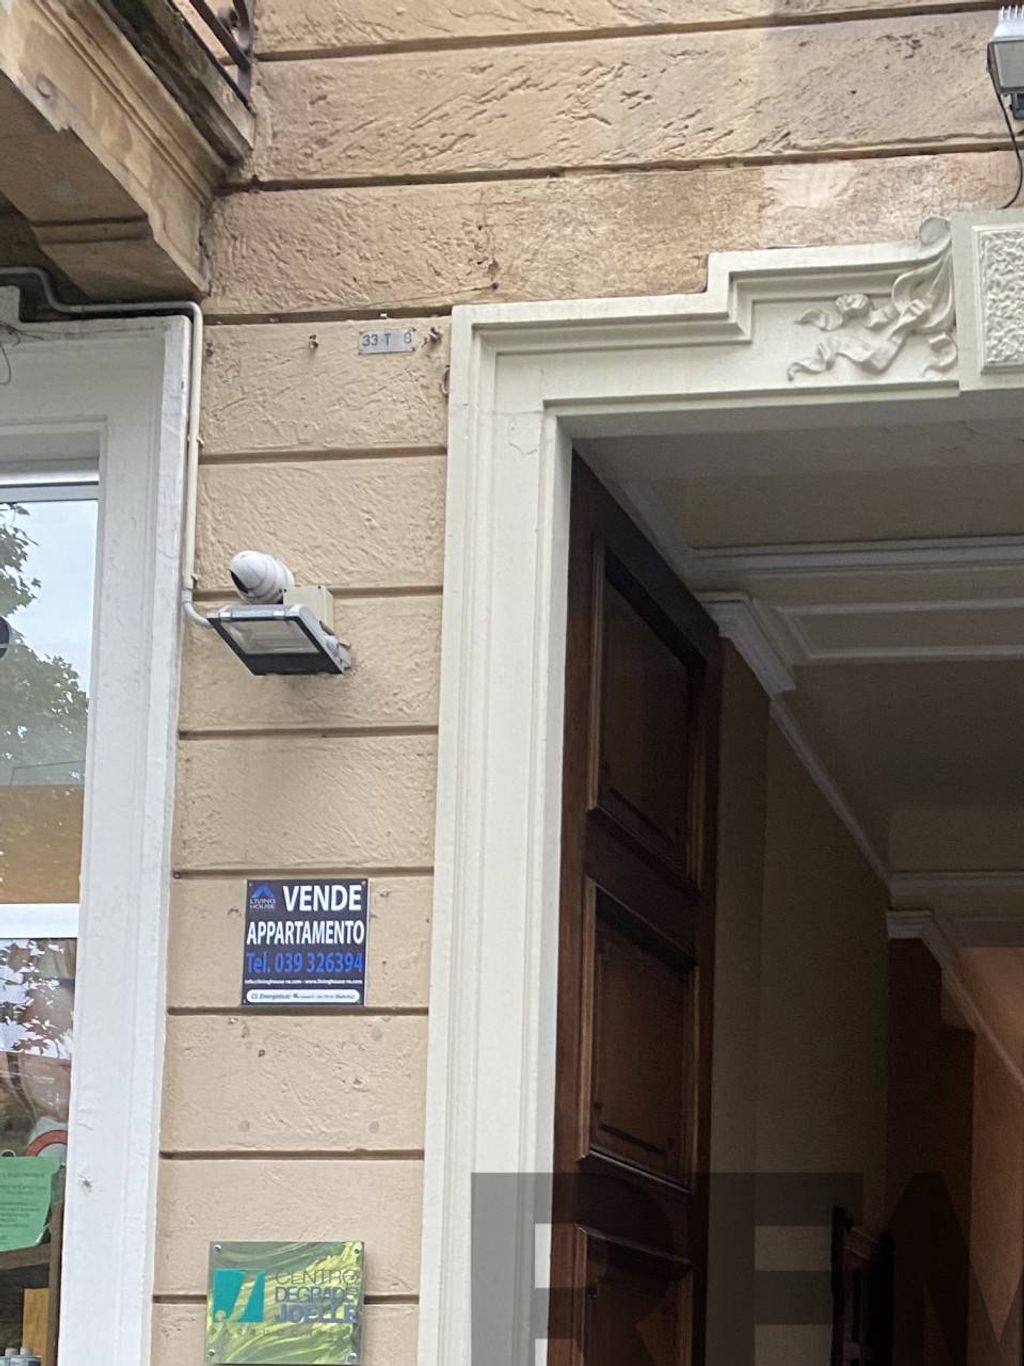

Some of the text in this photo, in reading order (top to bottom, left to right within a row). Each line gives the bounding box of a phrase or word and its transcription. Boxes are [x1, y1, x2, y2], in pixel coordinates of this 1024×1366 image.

[282, 884, 362, 912] VENDE
[246, 919, 365, 945] APPARTAMENTO
[246, 951, 363, 973] Tel. 039 326394
